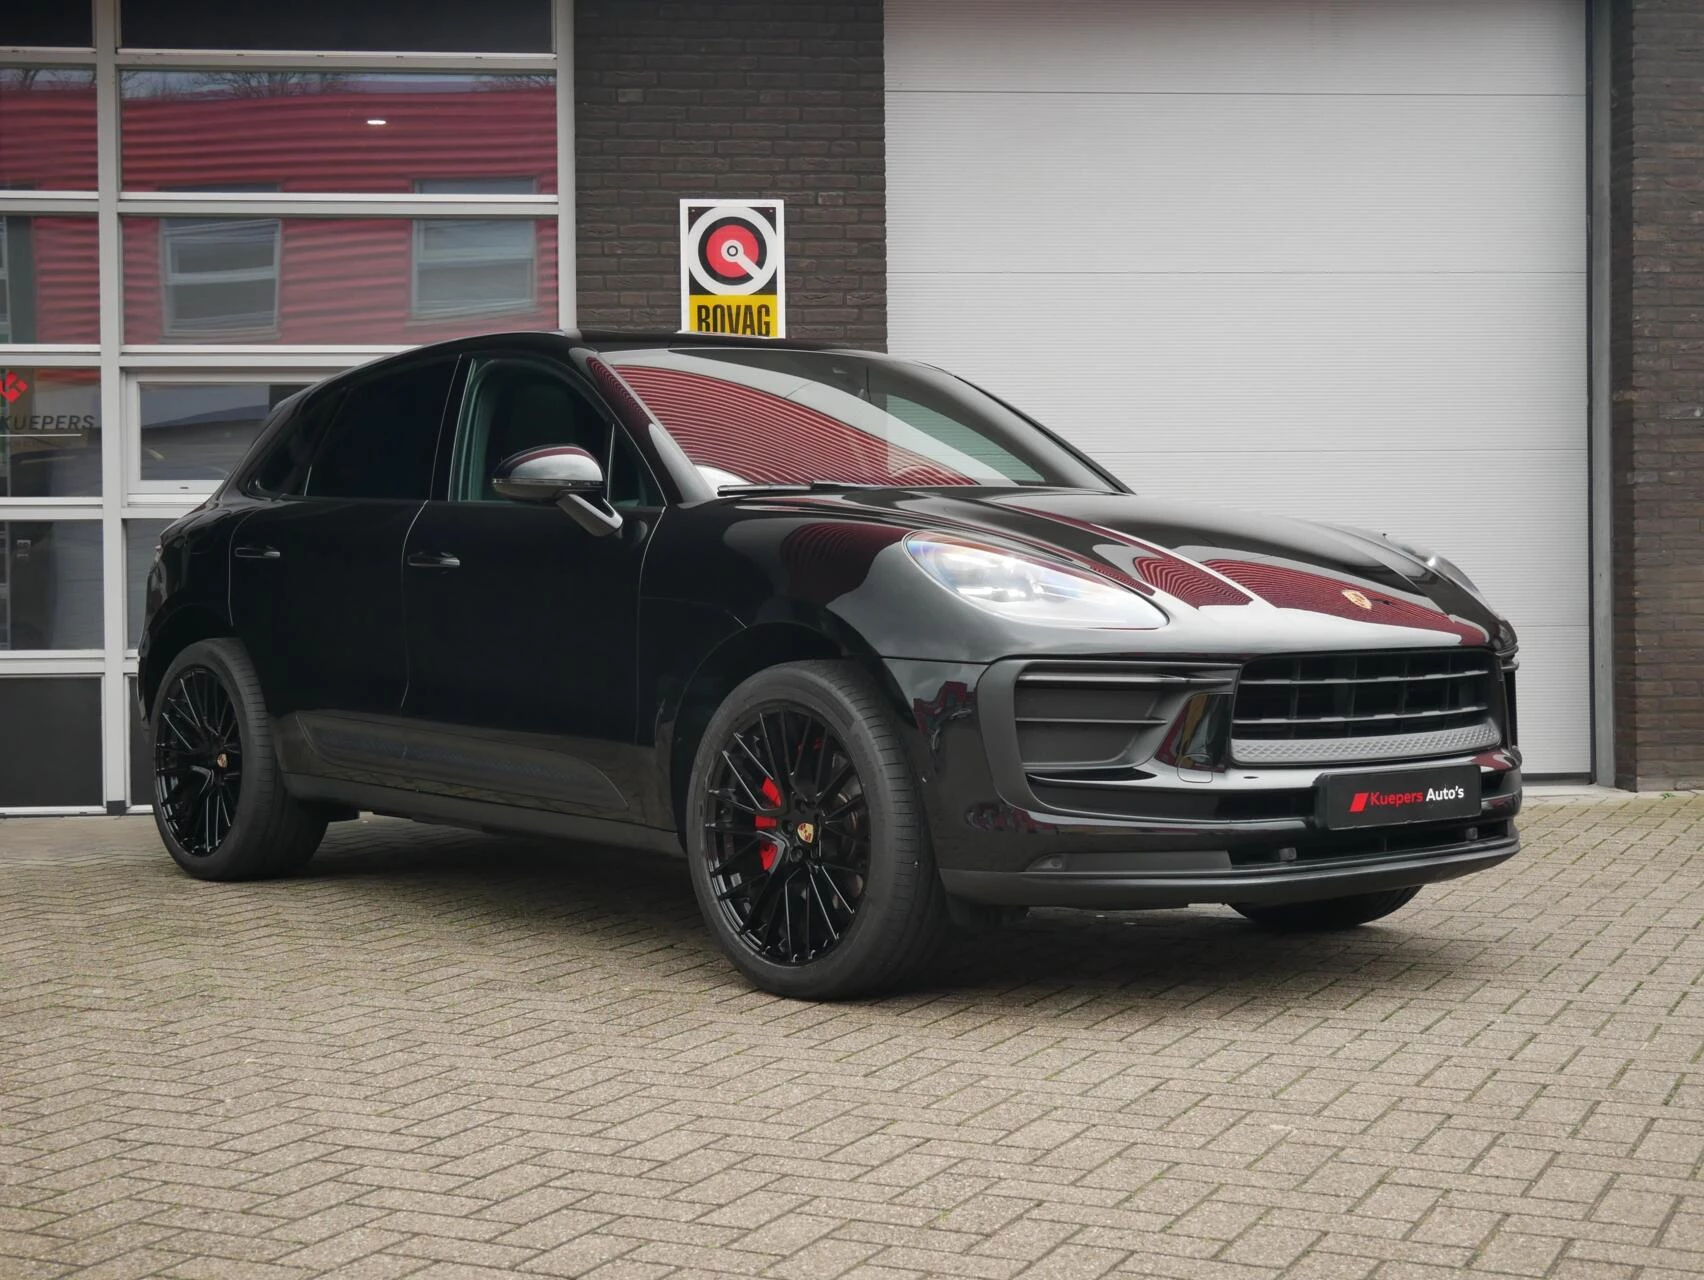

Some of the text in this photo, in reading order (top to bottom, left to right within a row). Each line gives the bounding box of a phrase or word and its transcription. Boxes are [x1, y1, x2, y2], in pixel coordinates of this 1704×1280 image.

[696, 303, 771, 337] BOVAG
[0, 414, 95, 431] KUEPERS
[1370, 785, 1464, 807] Kuepers Auto's
